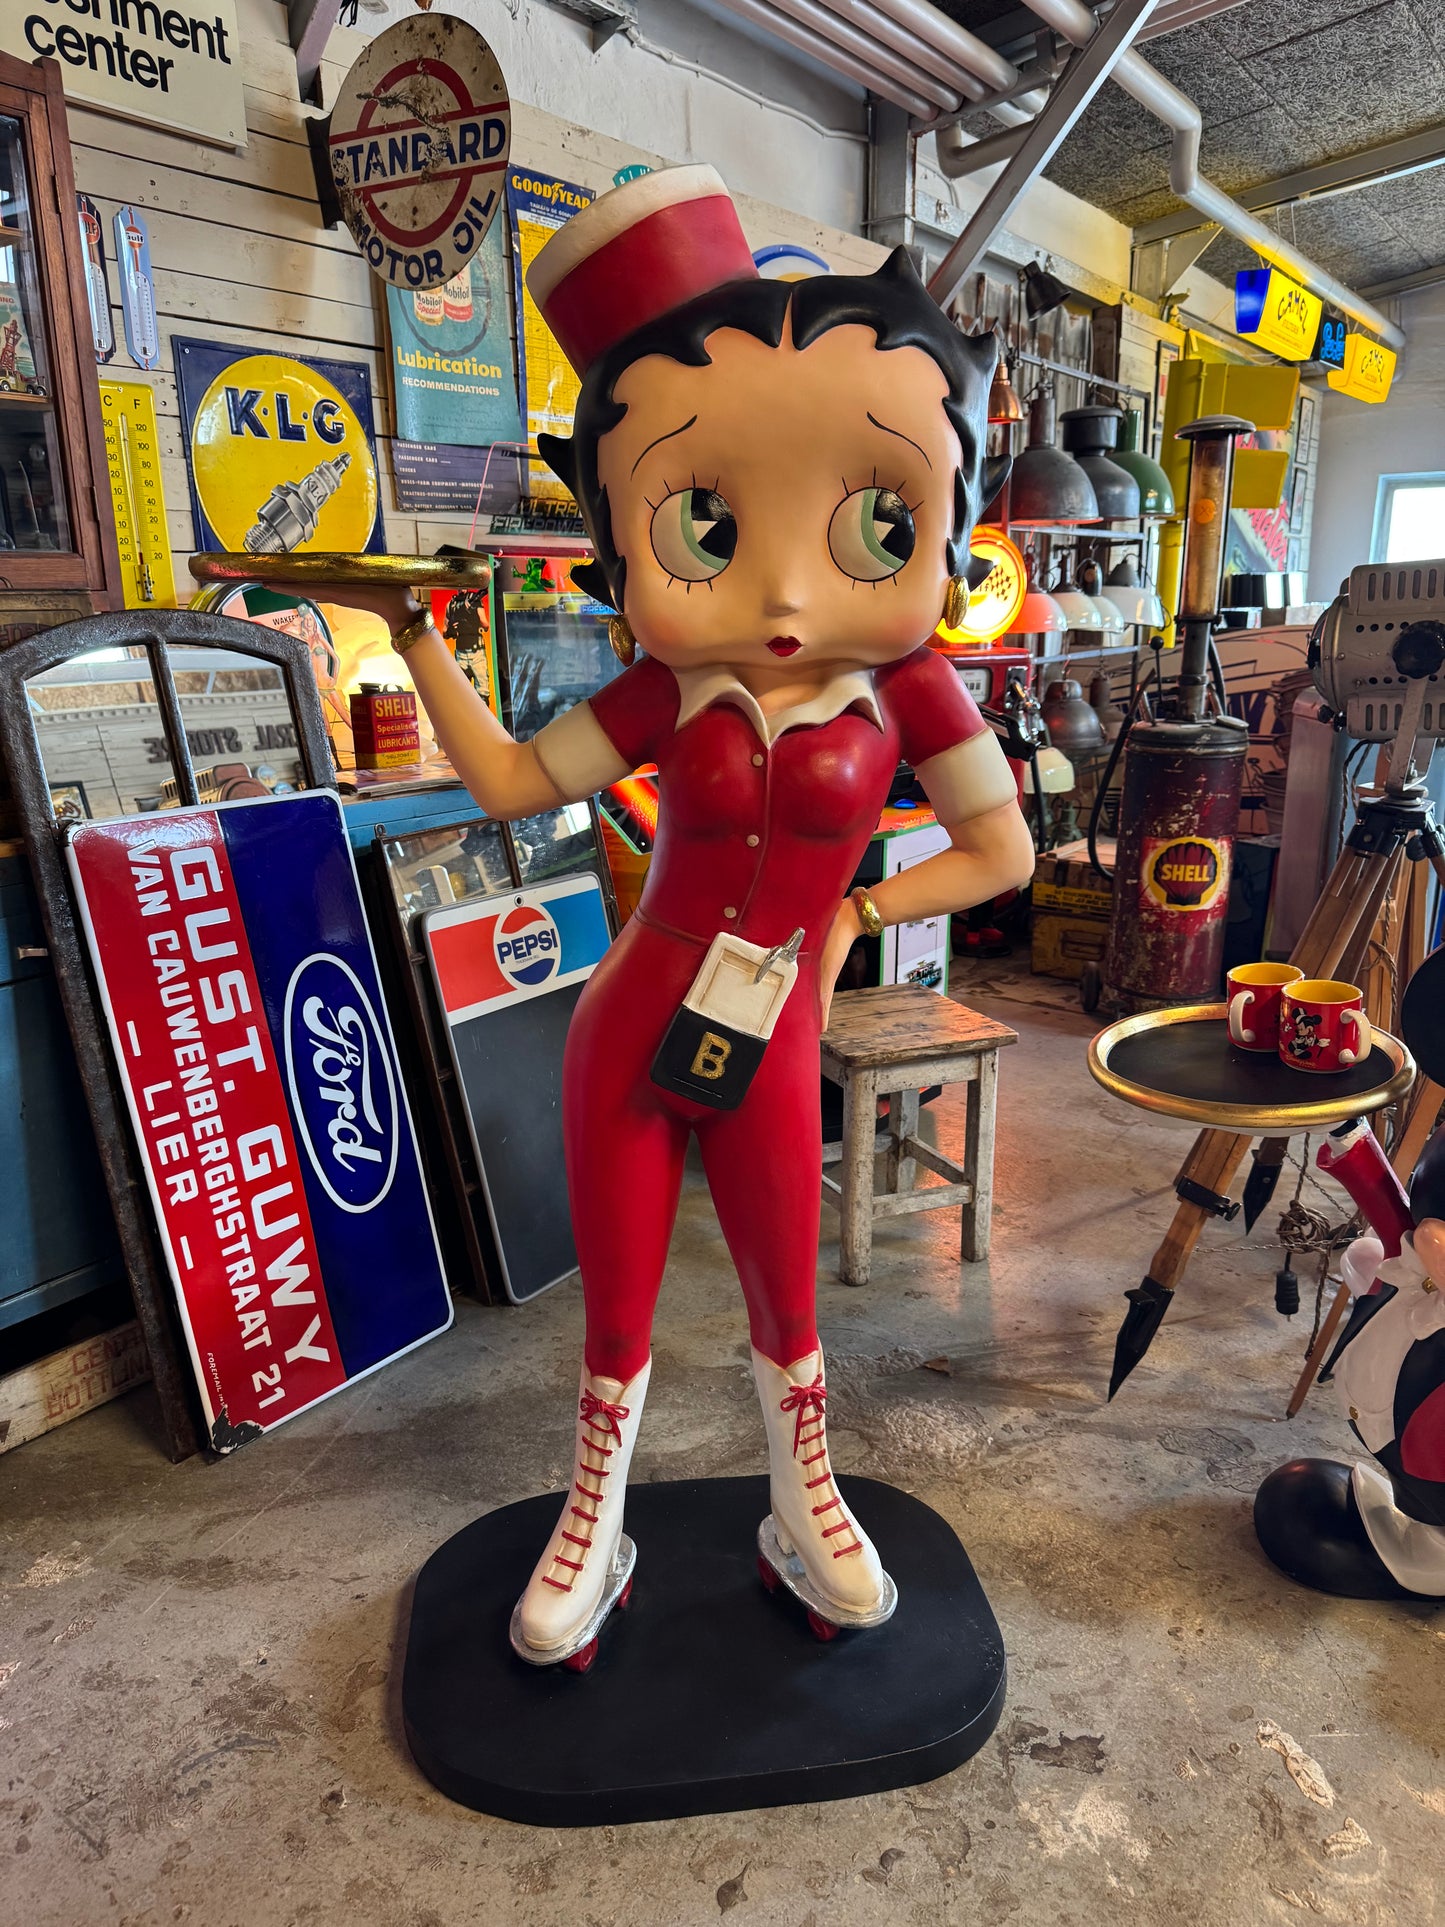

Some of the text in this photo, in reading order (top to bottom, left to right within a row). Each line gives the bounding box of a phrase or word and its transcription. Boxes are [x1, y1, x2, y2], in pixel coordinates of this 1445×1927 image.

[24, 14, 174, 92] center
[332, 118, 506, 187] STANDARD
[355, 189, 496, 286] MOTOR OIL
[445, 283, 469, 299] Mobiloil
[416, 290, 443, 306] Mobiloil
[1278, 290, 1308, 334] CAMEL
[397, 346, 502, 378] Lubrication
[402, 376, 500, 396] RECOMMENDATIONS
[103, 394, 113, 407] C
[133, 398, 141, 410] F
[135, 423, 147, 432] 120
[105, 436, 116, 445] 40
[138, 442, 150, 450] 100
[108, 453, 118, 461] 30
[142, 460, 151, 469] 80
[110, 470, 121, 478] 20
[144, 479, 154, 487] 60
[113, 487, 123, 495] 10
[117, 503, 123, 511] 0
[146, 498, 156, 506] 40
[118, 520, 127, 528] 10
[149, 515, 159, 524] 20
[120, 537, 129, 545] 20
[153, 534, 159, 542] 0
[121, 553, 132, 561] 30
[153, 552, 163, 560] 20
[375, 697, 415, 718] SHELL
[378, 735, 417, 749] LUBRICANTS
[1160, 863, 1210, 883] SHELL
[497, 928, 558, 965] PEPSI
[690, 1031, 732, 1080] B
[302, 995, 384, 1173] Ford
[169, 846, 331, 1364] GUST. GUWY
[128, 839, 286, 1410] VAN CAUWENBERGHSTRAAT 21
[142, 1080, 199, 1206] LIER
[207, 1352, 222, 1393] FOREMAIL
